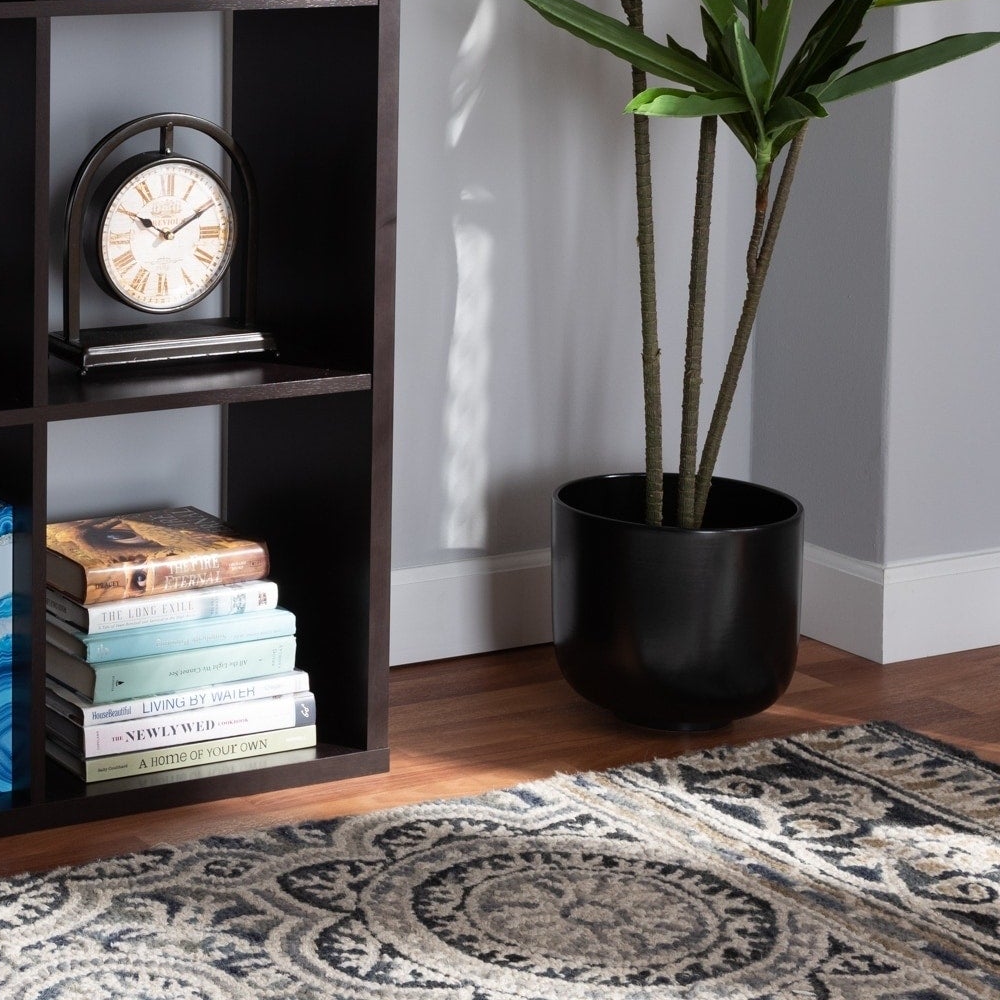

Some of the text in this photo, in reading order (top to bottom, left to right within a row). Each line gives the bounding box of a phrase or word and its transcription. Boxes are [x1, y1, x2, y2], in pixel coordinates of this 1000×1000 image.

[164, 571, 223, 590] ETERNAL
[101, 609, 124, 622] THE
[128, 605, 158, 619] LONG
[162, 600, 195, 616] EXILE
[142, 697, 186, 714] LIVING
[189, 693, 207, 707] BY
[211, 686, 256, 703] WATER
[125, 719, 216, 743] NEWLYWED
[138, 759, 149, 769] A
[189, 749, 204, 761] OF
[240, 738, 269, 753] OWN
